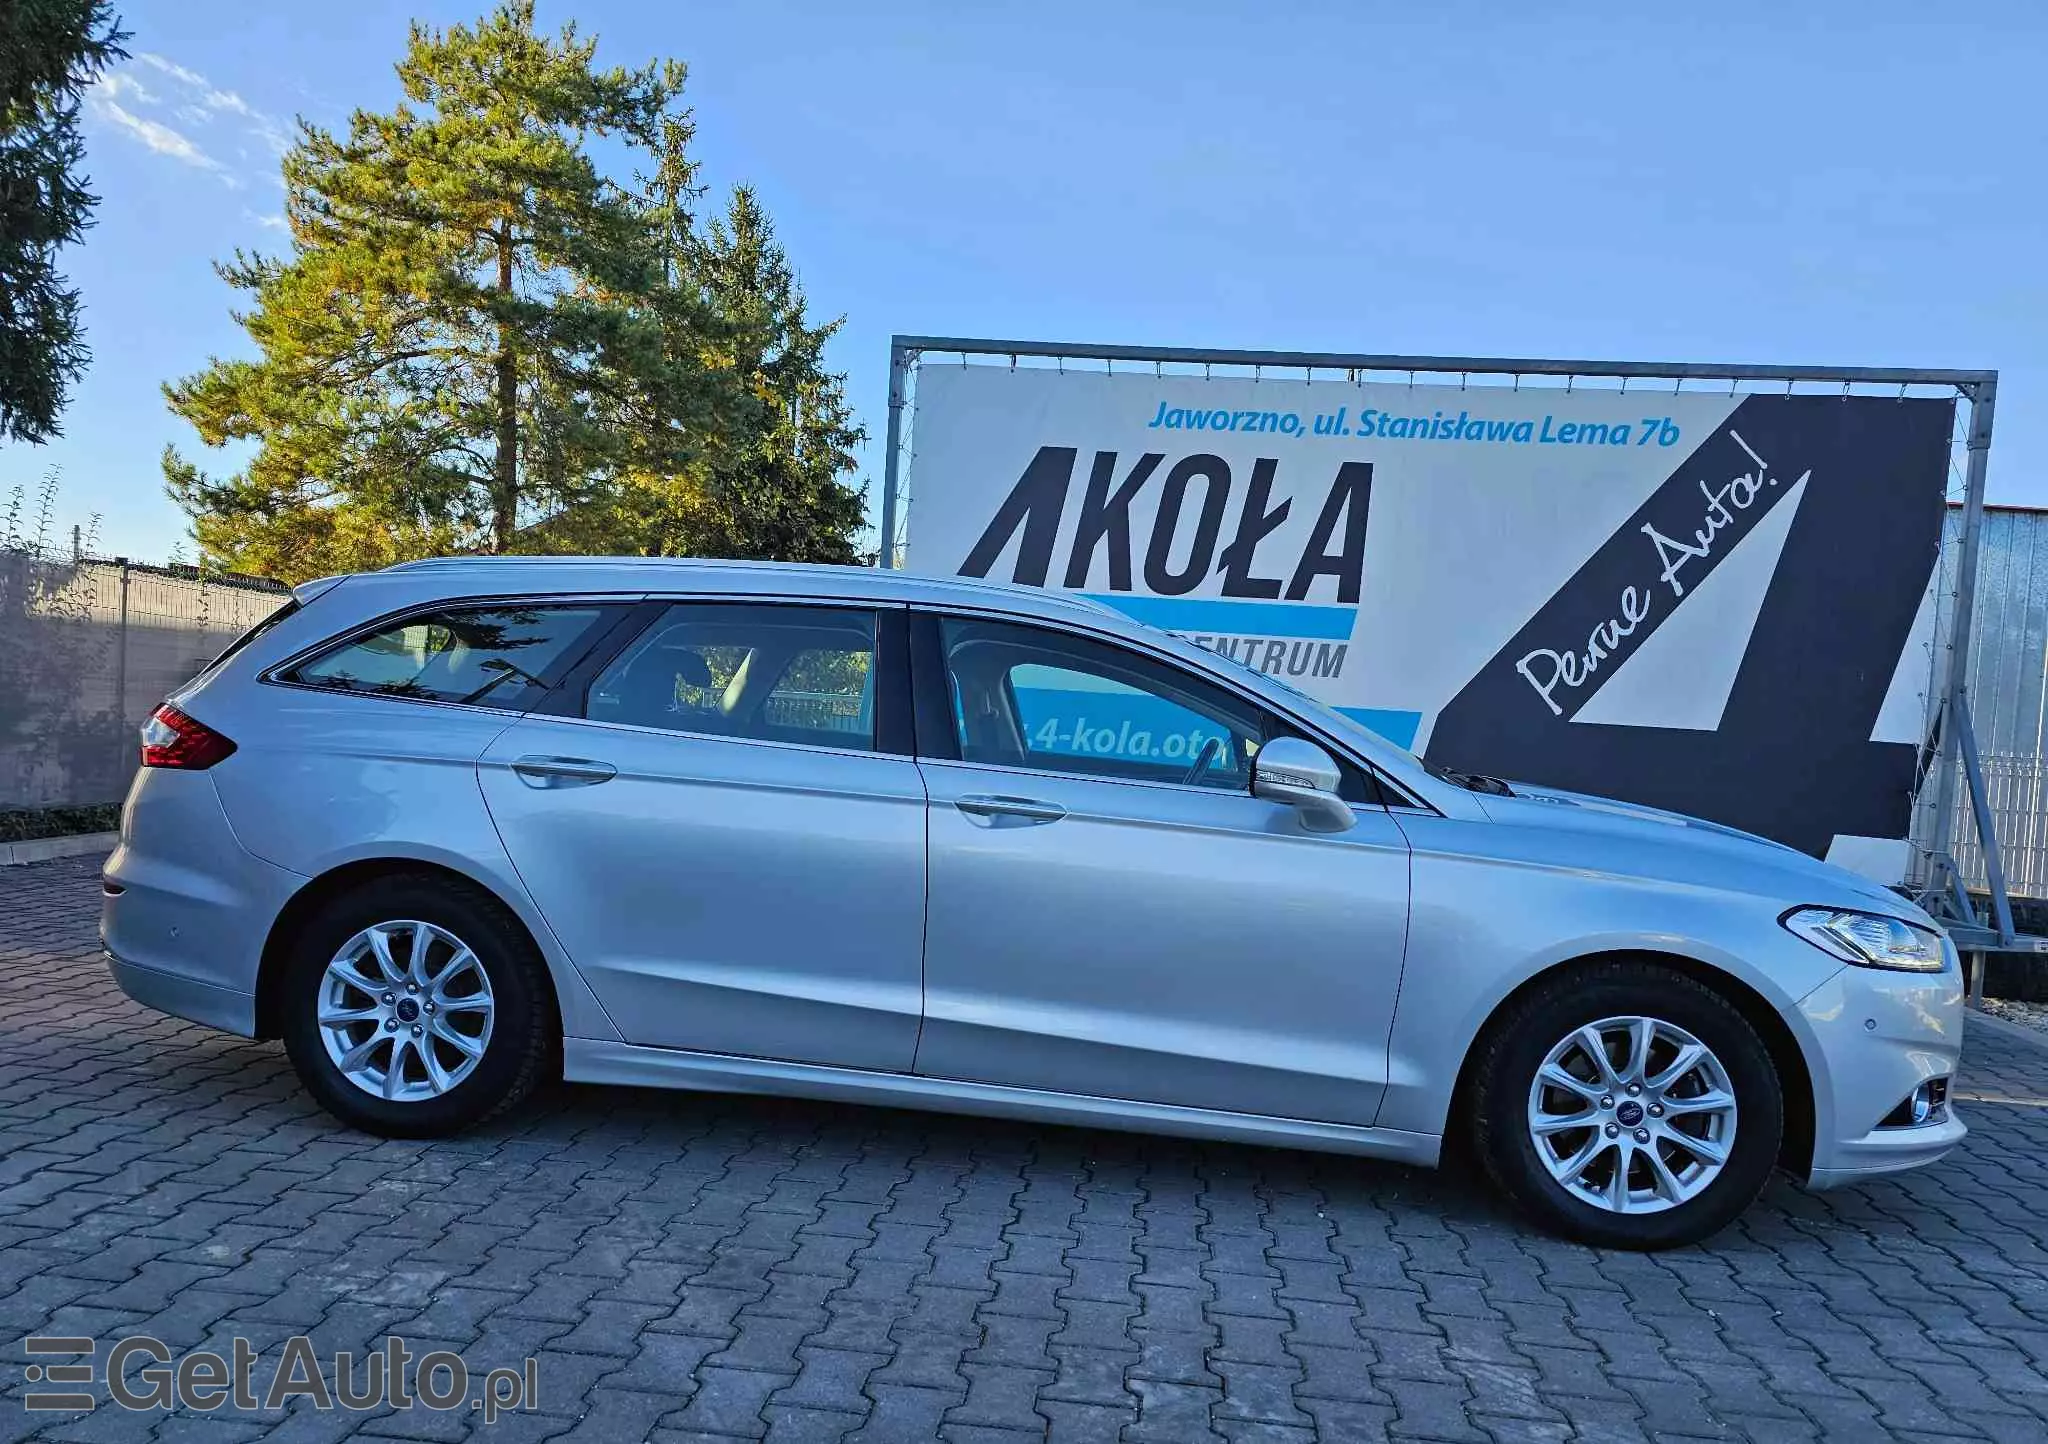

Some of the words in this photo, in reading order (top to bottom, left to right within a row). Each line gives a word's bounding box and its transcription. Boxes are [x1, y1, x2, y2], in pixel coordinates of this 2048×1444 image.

[1148, 401, 1305, 438] Jaworzno,
[1313, 407, 1350, 436] ul.
[1357, 409, 1535, 443] Stanisława
[1539, 416, 1631, 446] Lema
[1637, 417, 1680, 447] 7b
[1640, 429, 1778, 597] Auta!
